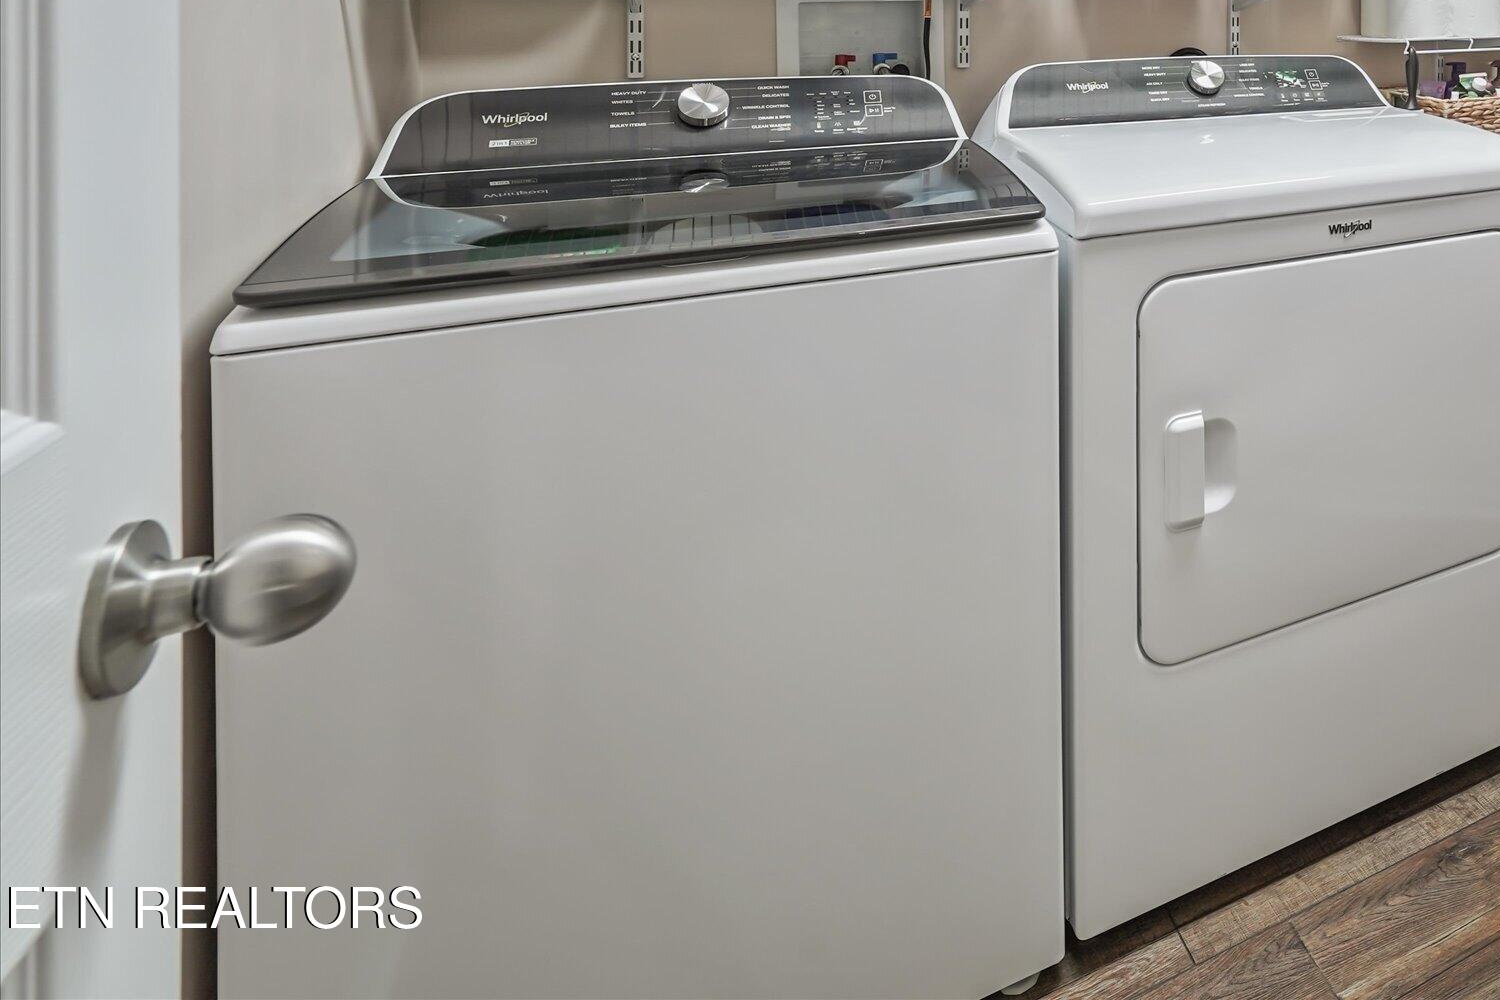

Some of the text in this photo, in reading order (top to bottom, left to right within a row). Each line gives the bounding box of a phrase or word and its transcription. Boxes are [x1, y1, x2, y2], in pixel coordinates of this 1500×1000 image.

[1067, 82, 1109, 92] Whirlpool
[481, 112, 549, 125] Whirlpool
[1328, 219, 1373, 237] Whirlpool
